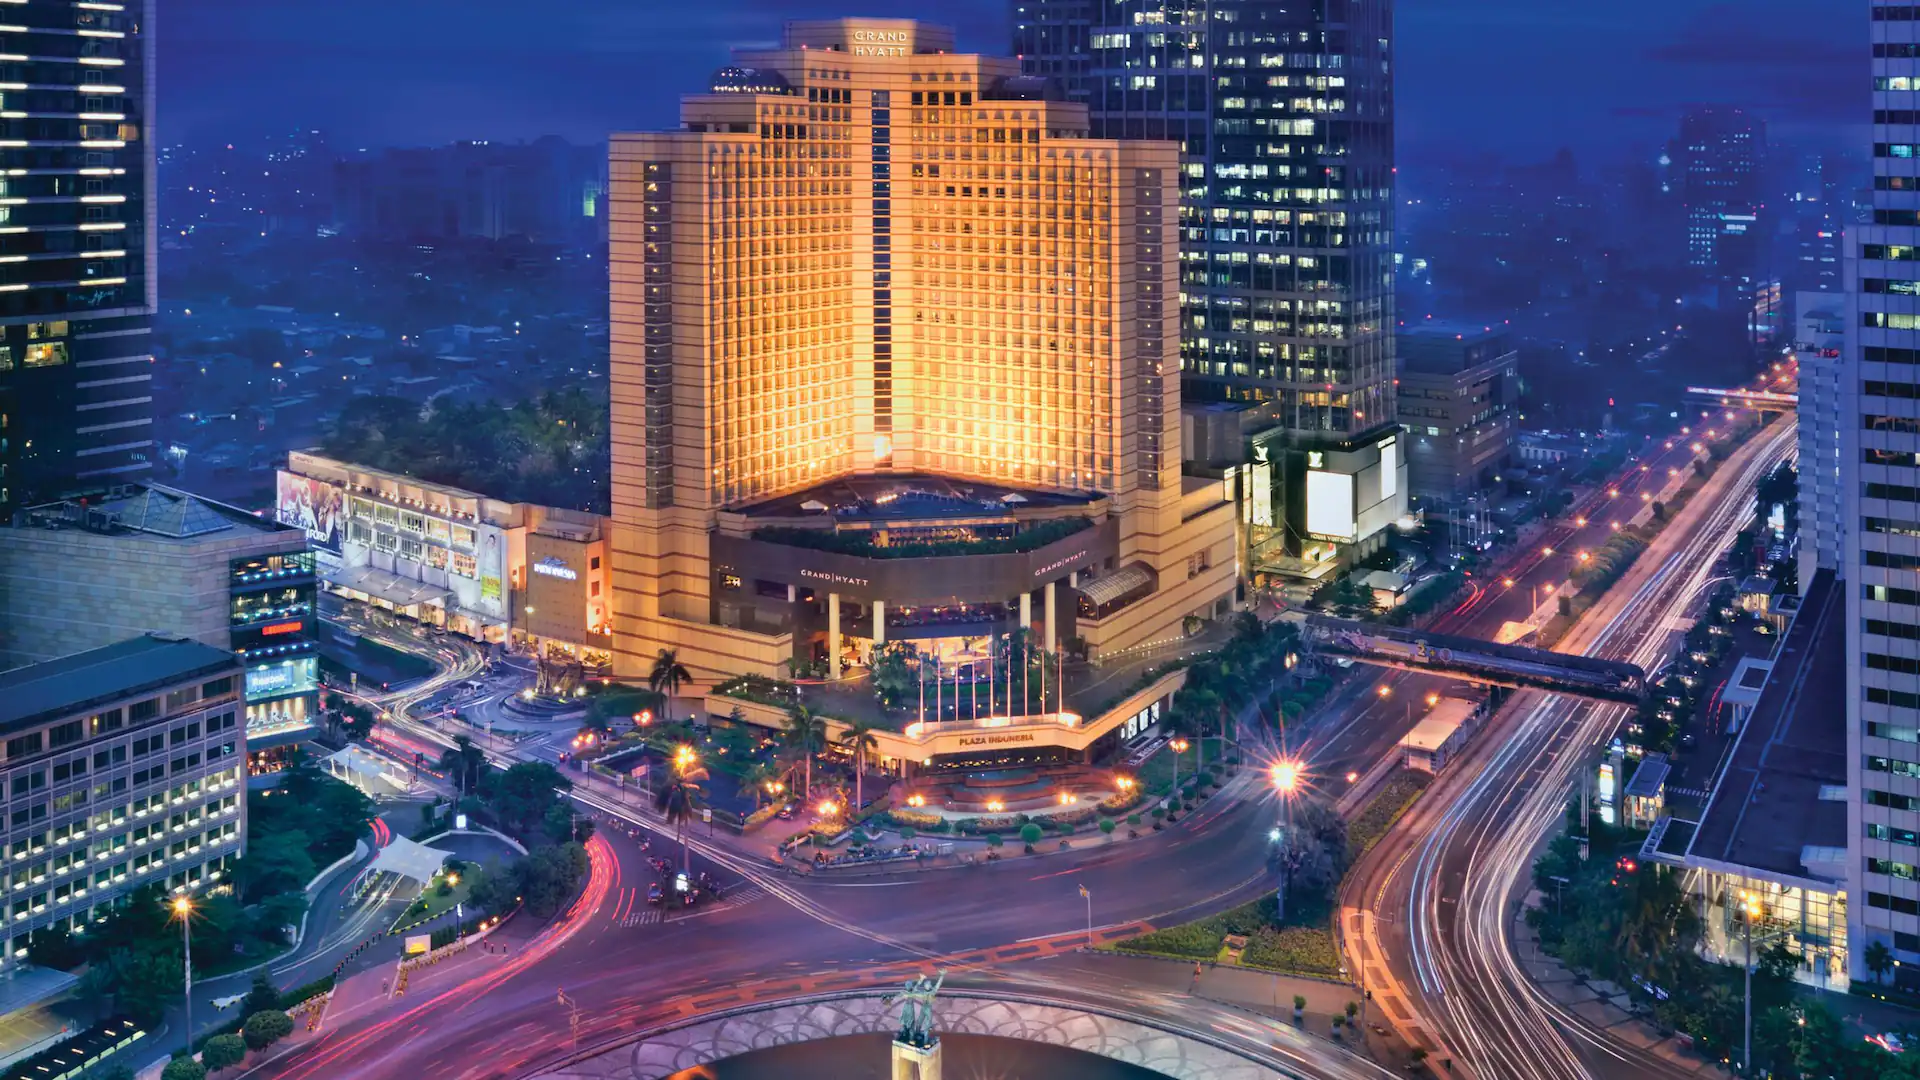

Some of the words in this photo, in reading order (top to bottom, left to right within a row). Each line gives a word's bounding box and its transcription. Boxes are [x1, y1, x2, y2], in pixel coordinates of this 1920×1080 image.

[854, 30, 907, 42] GRAND
[855, 46, 905, 57] HYATT
[1034, 561, 1062, 577] GRAND
[1064, 550, 1087, 565] HYATT
[800, 569, 831, 581] GRAND
[835, 575, 868, 587] HYATT
[246, 708, 295, 728] ZARA
[959, 737, 986, 746] PLAZA
[988, 733, 1034, 744] INDONESIA
